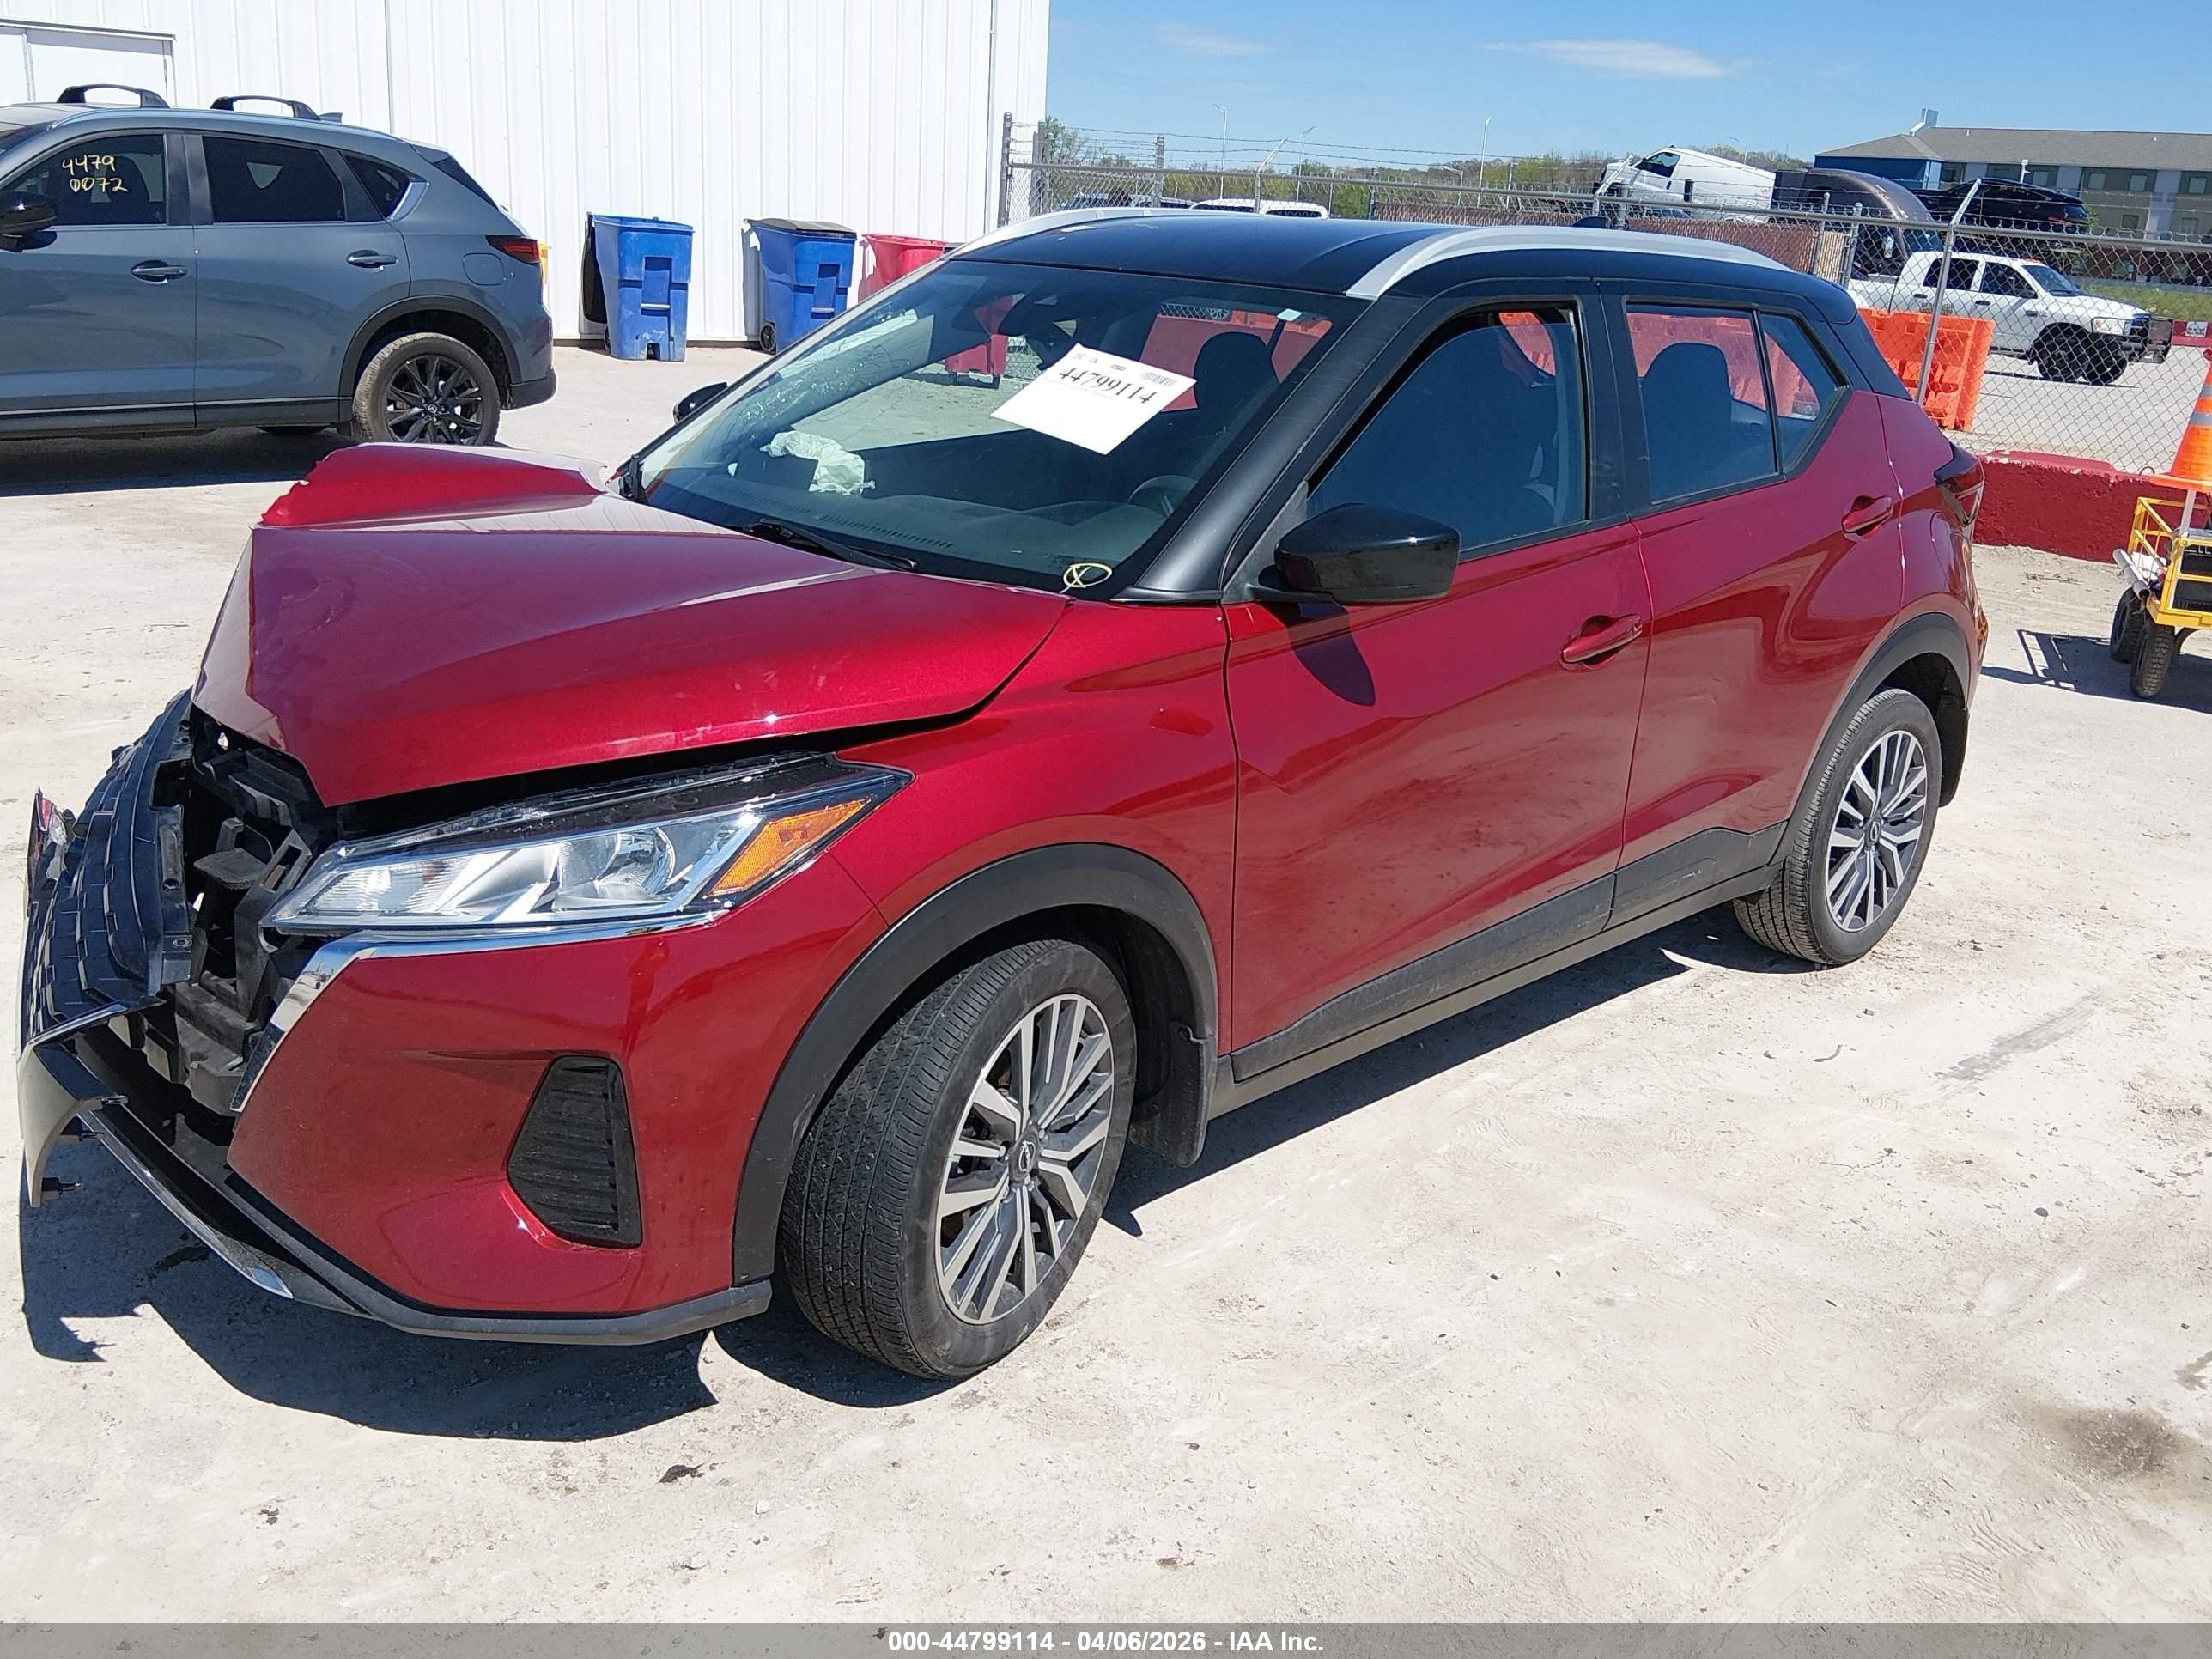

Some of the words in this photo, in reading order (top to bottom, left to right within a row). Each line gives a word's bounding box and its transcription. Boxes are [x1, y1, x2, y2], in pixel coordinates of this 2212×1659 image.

[62, 154, 116, 176] 4479
[69, 177, 129, 193] 0072
[1058, 367, 1159, 404] 44799114
